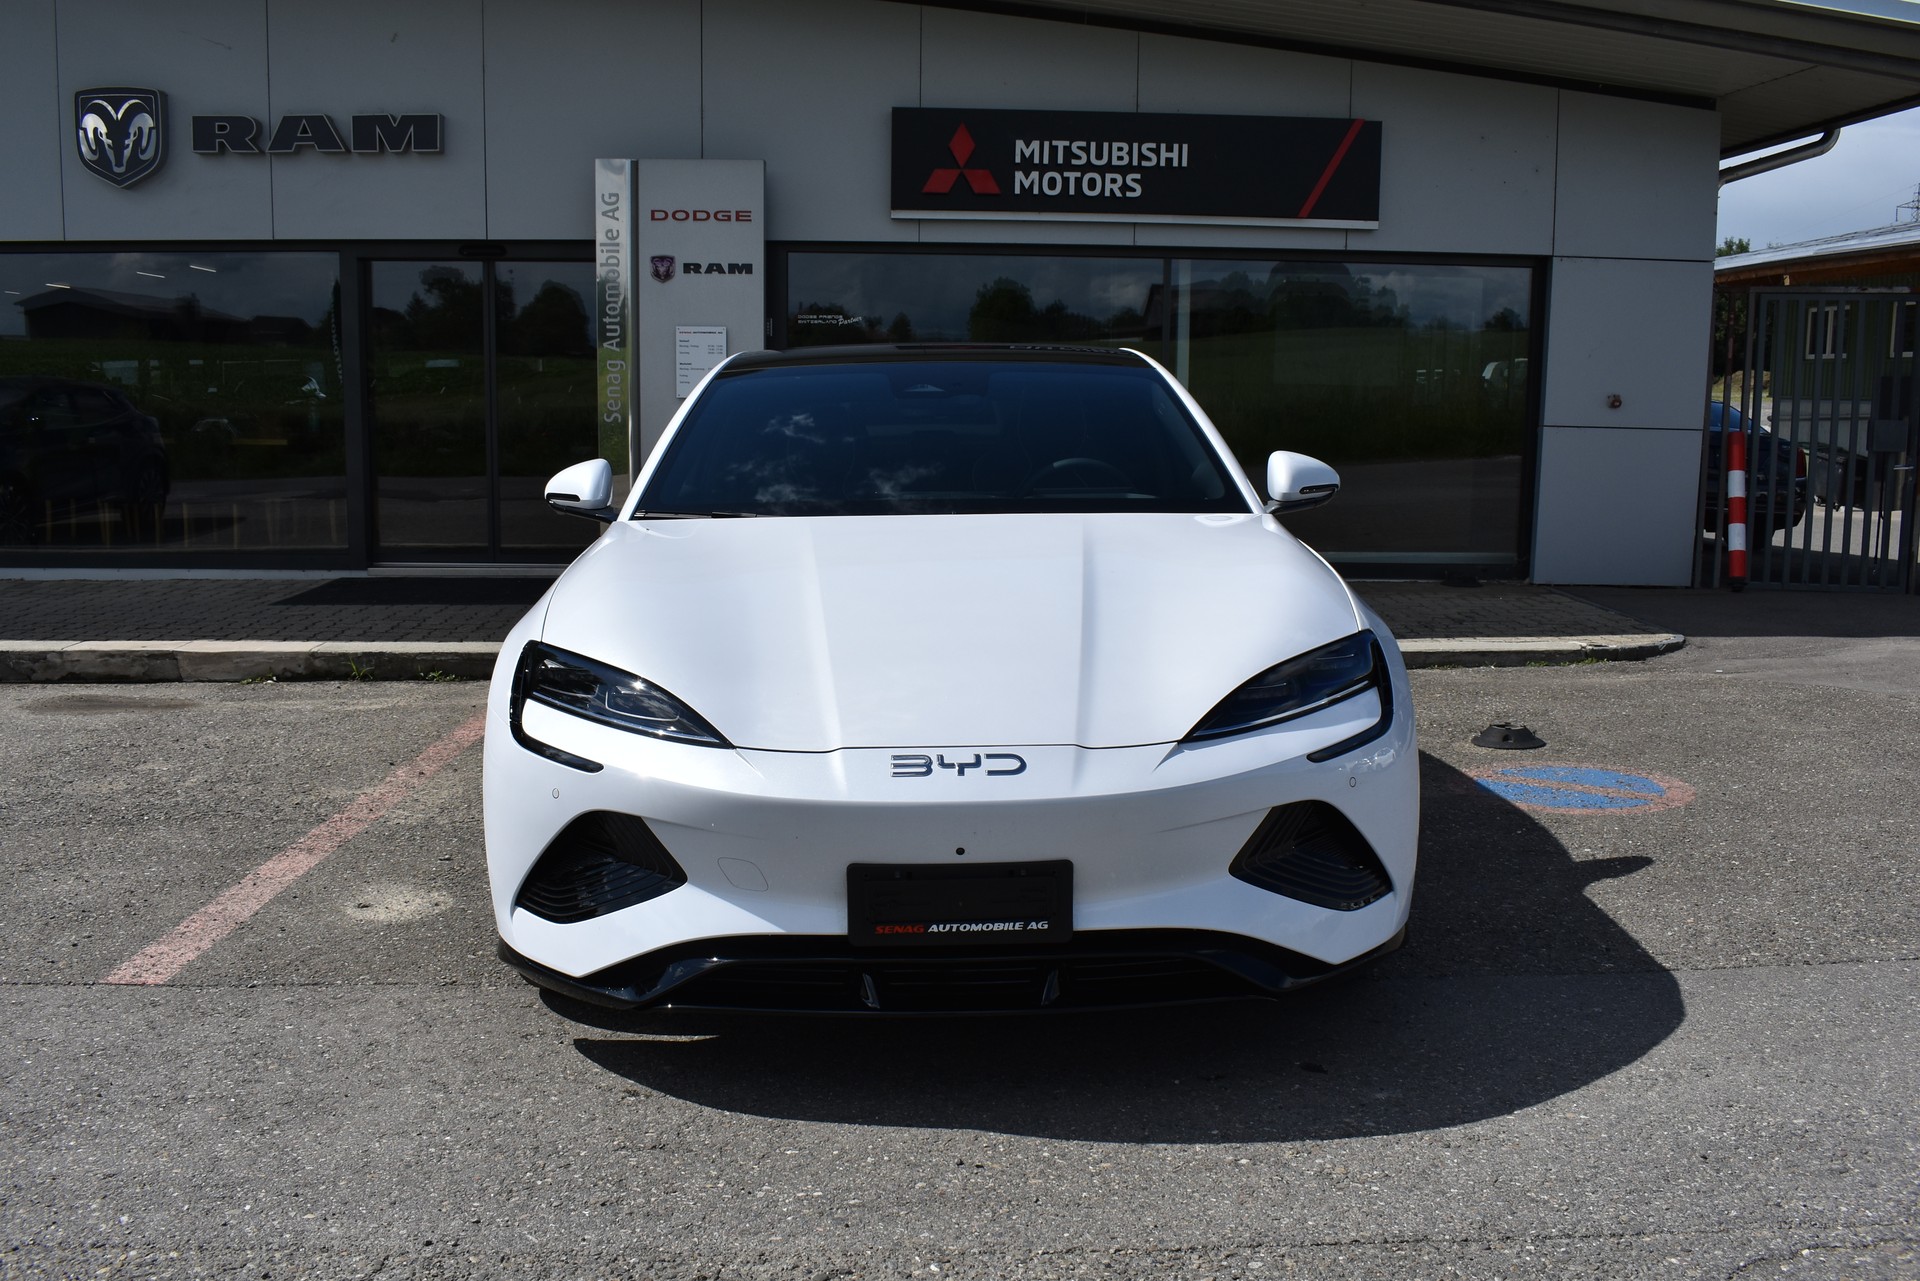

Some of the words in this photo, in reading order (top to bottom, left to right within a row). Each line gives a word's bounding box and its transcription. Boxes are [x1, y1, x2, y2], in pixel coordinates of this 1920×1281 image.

[191, 113, 442, 153] RAM
[1014, 139, 1189, 168] MITSUBISHI
[1014, 170, 1143, 198] MOTORS
[601, 192, 620, 222] AG
[650, 209, 753, 223] DODGE
[682, 261, 754, 275] RAM
[600, 228, 621, 352] Automobile
[603, 359, 626, 423] Senag
[890, 753, 1027, 777] BYD
[874, 924, 925, 935] SENAG
[927, 921, 1024, 933] AUTOMOBILE
[1026, 920, 1049, 931] AG
